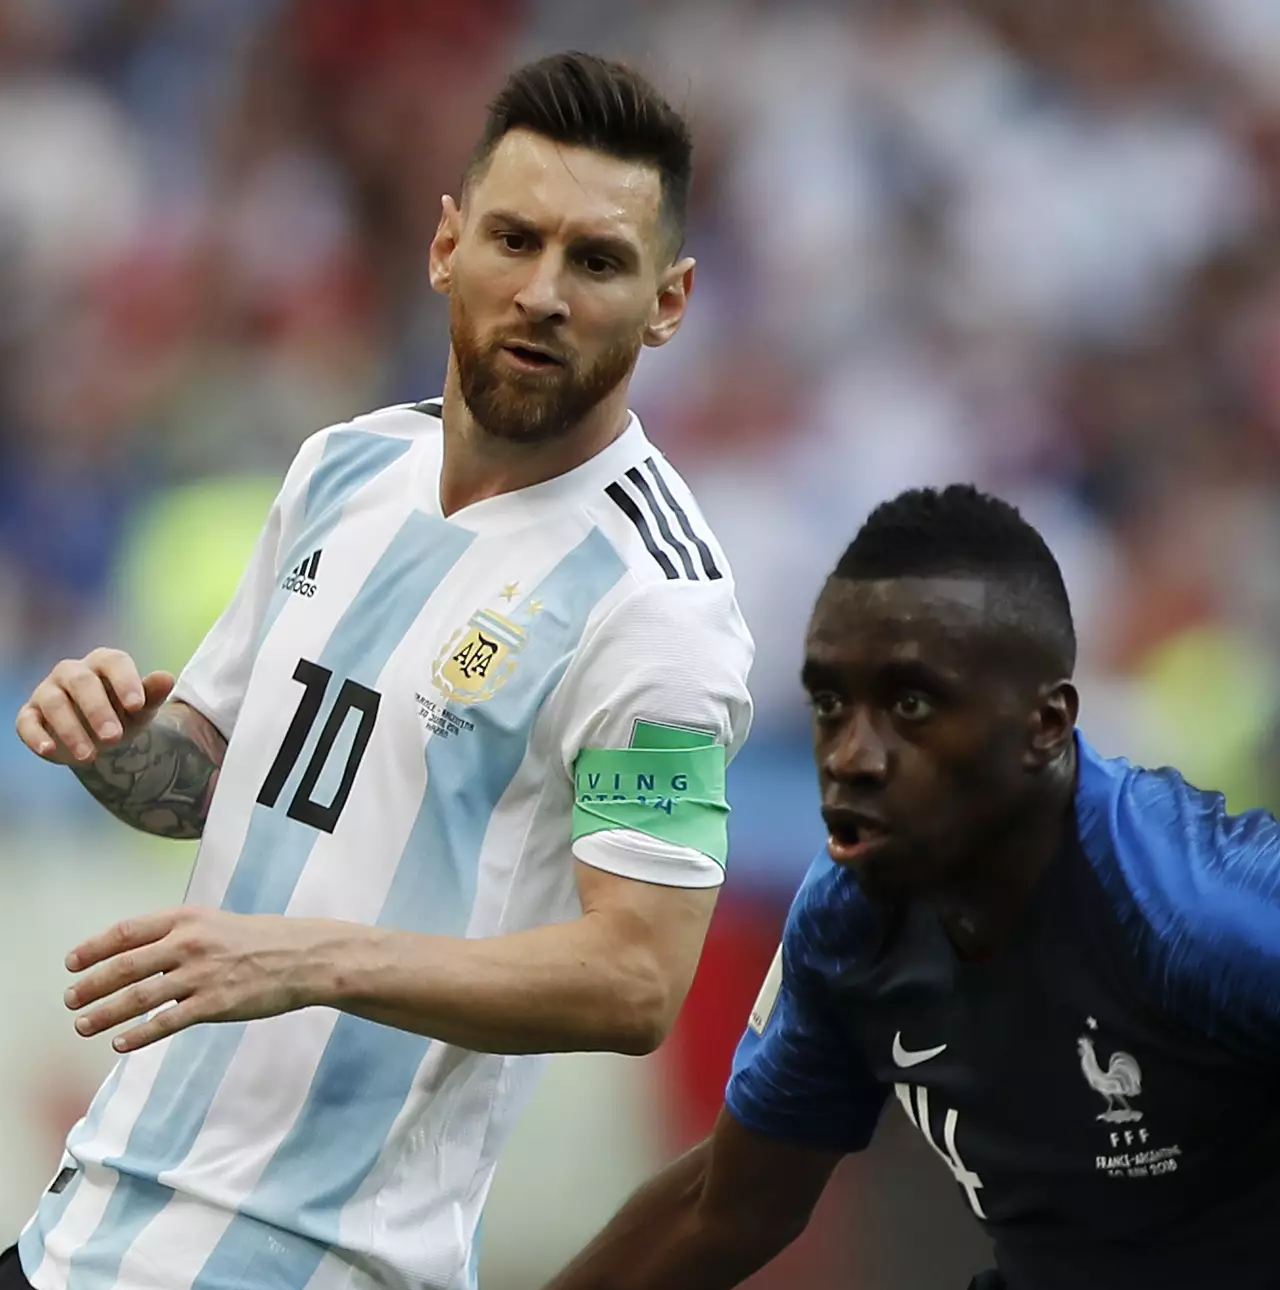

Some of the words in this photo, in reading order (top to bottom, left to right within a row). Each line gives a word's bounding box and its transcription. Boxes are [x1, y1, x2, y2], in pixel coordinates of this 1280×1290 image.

[281, 574, 318, 598] adidas
[256, 657, 382, 834] 10
[576, 773, 688, 791] IVING
